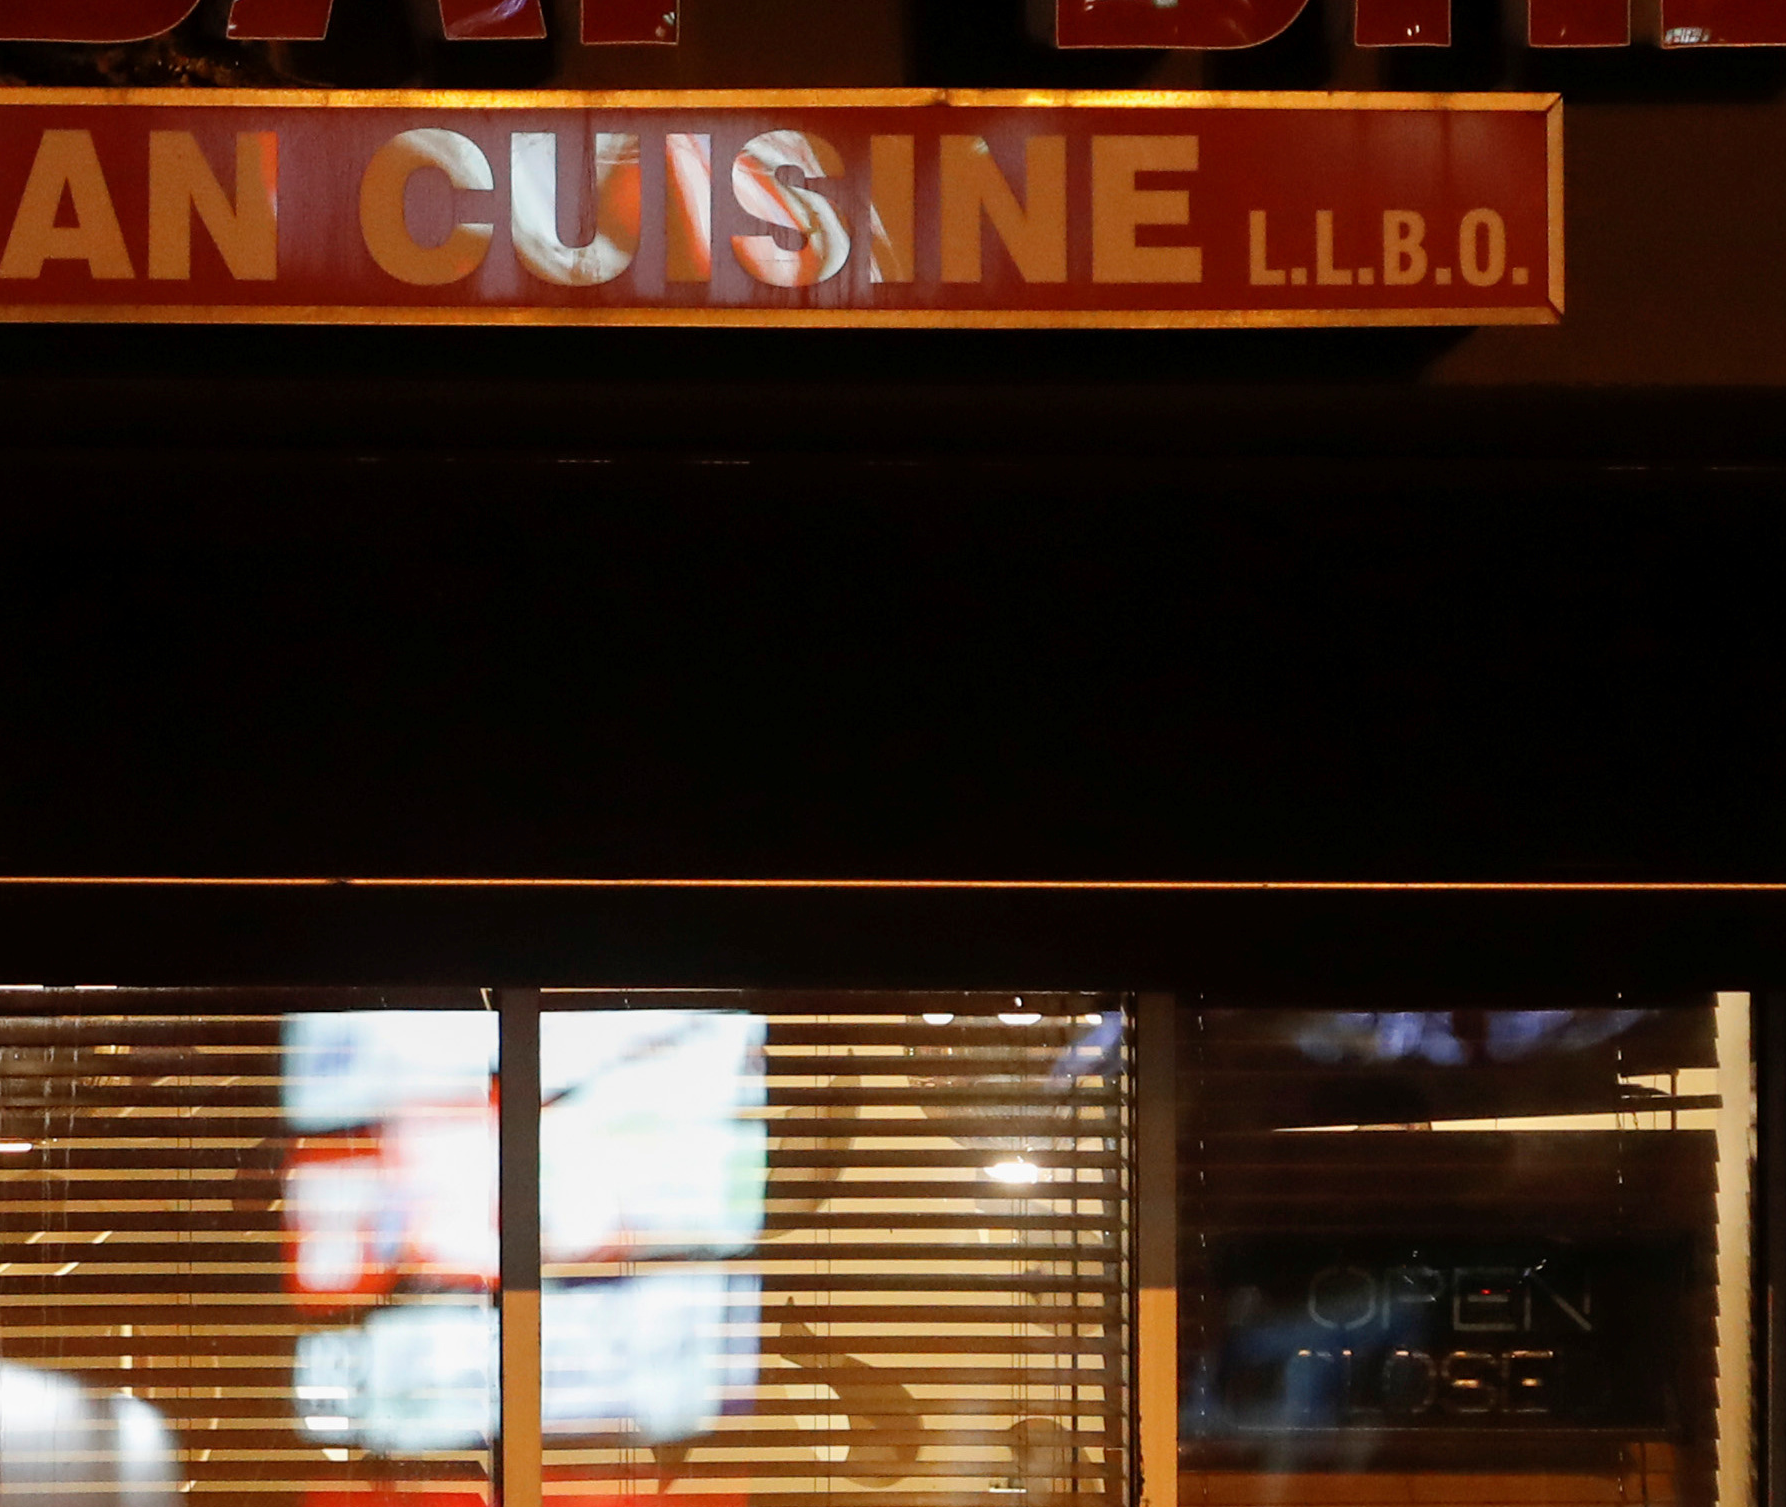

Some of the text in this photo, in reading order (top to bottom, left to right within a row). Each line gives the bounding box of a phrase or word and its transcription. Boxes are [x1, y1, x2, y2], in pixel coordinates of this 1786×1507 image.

[358, 127, 1202, 290] CUISINE
[1248, 208, 1530, 291] L.L.B.O.
[1307, 1266, 1593, 1331] OPEN
